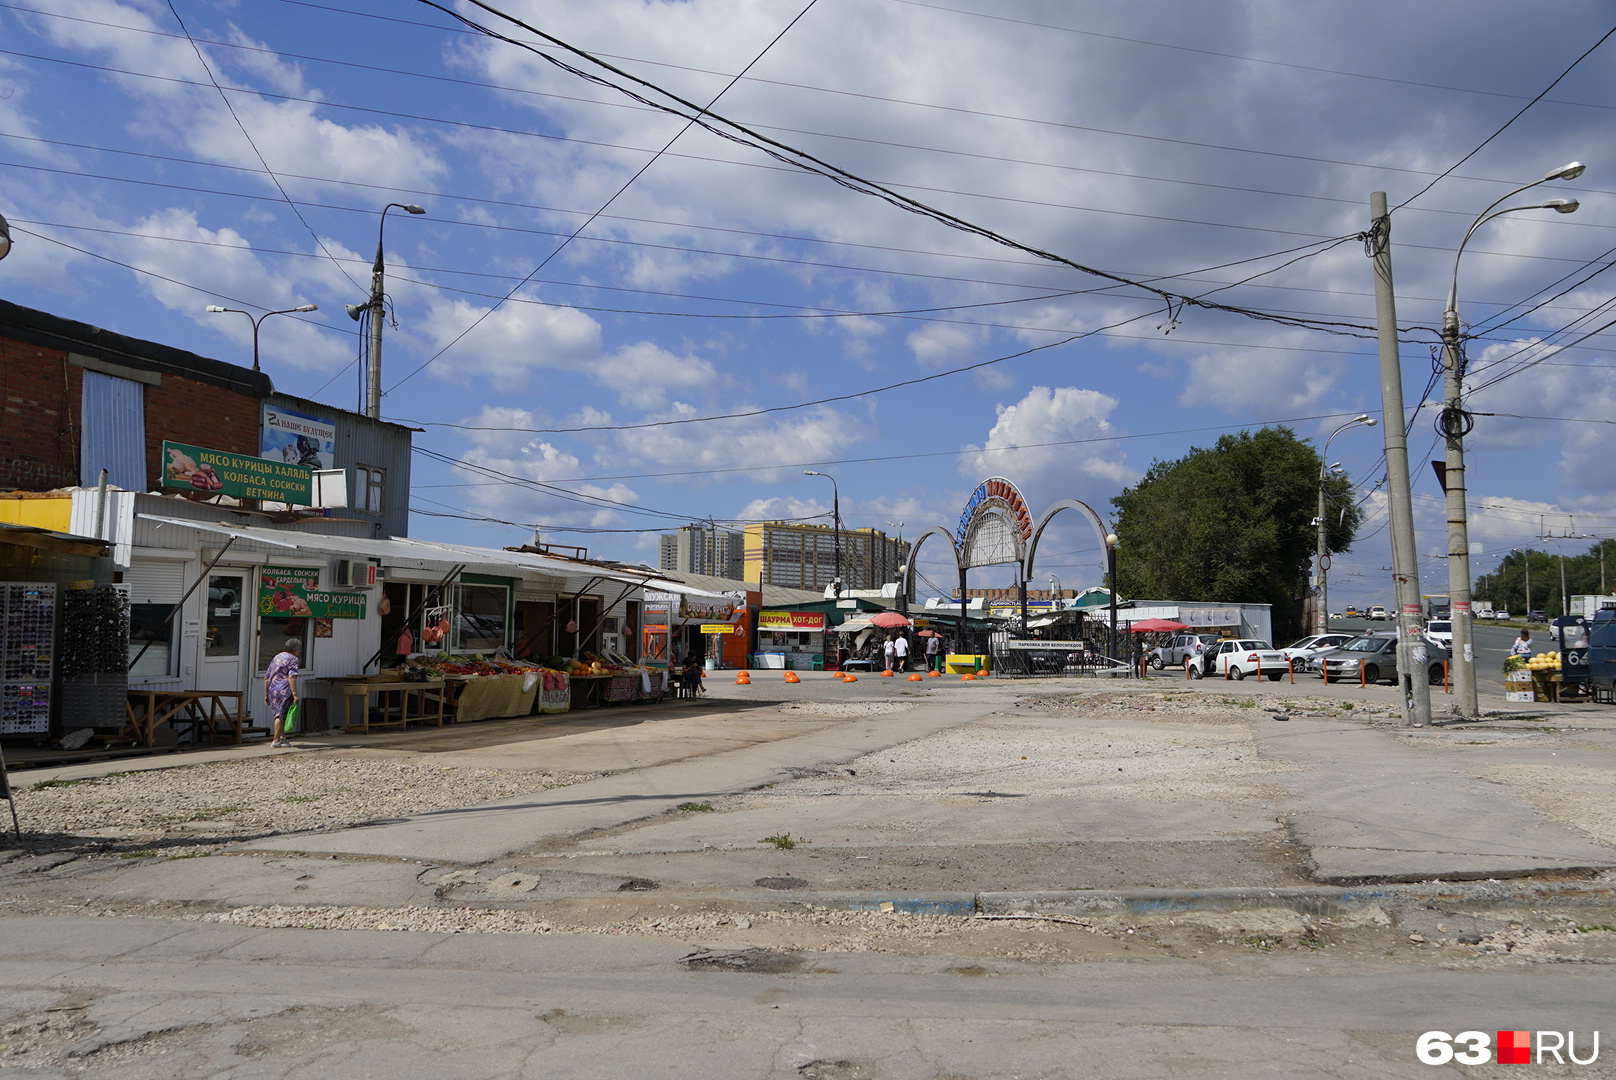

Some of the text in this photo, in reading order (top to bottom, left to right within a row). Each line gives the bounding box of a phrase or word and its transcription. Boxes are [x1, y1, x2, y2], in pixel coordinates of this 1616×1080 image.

[281, 420, 302, 432] НАШЕ
[302, 425, 334, 440] БУДУЩЕЕ
[200, 452, 311, 481] МЯСО КУРИЦЫ ХАЛЯЛЬ
[223, 470, 306, 493] КОЛБАСА СОСИСКИ
[246, 486, 285, 501] ВЕТЧИНА
[262, 568, 319, 577] КОЛБАСА СОСИСКИ
[276, 576, 307, 584] САРДЕЛЬКИ
[306, 593, 366, 606] МЯСО КУРИЦА
[760, 615, 823, 625] ШАУРМА ХОТ-ДОГ
